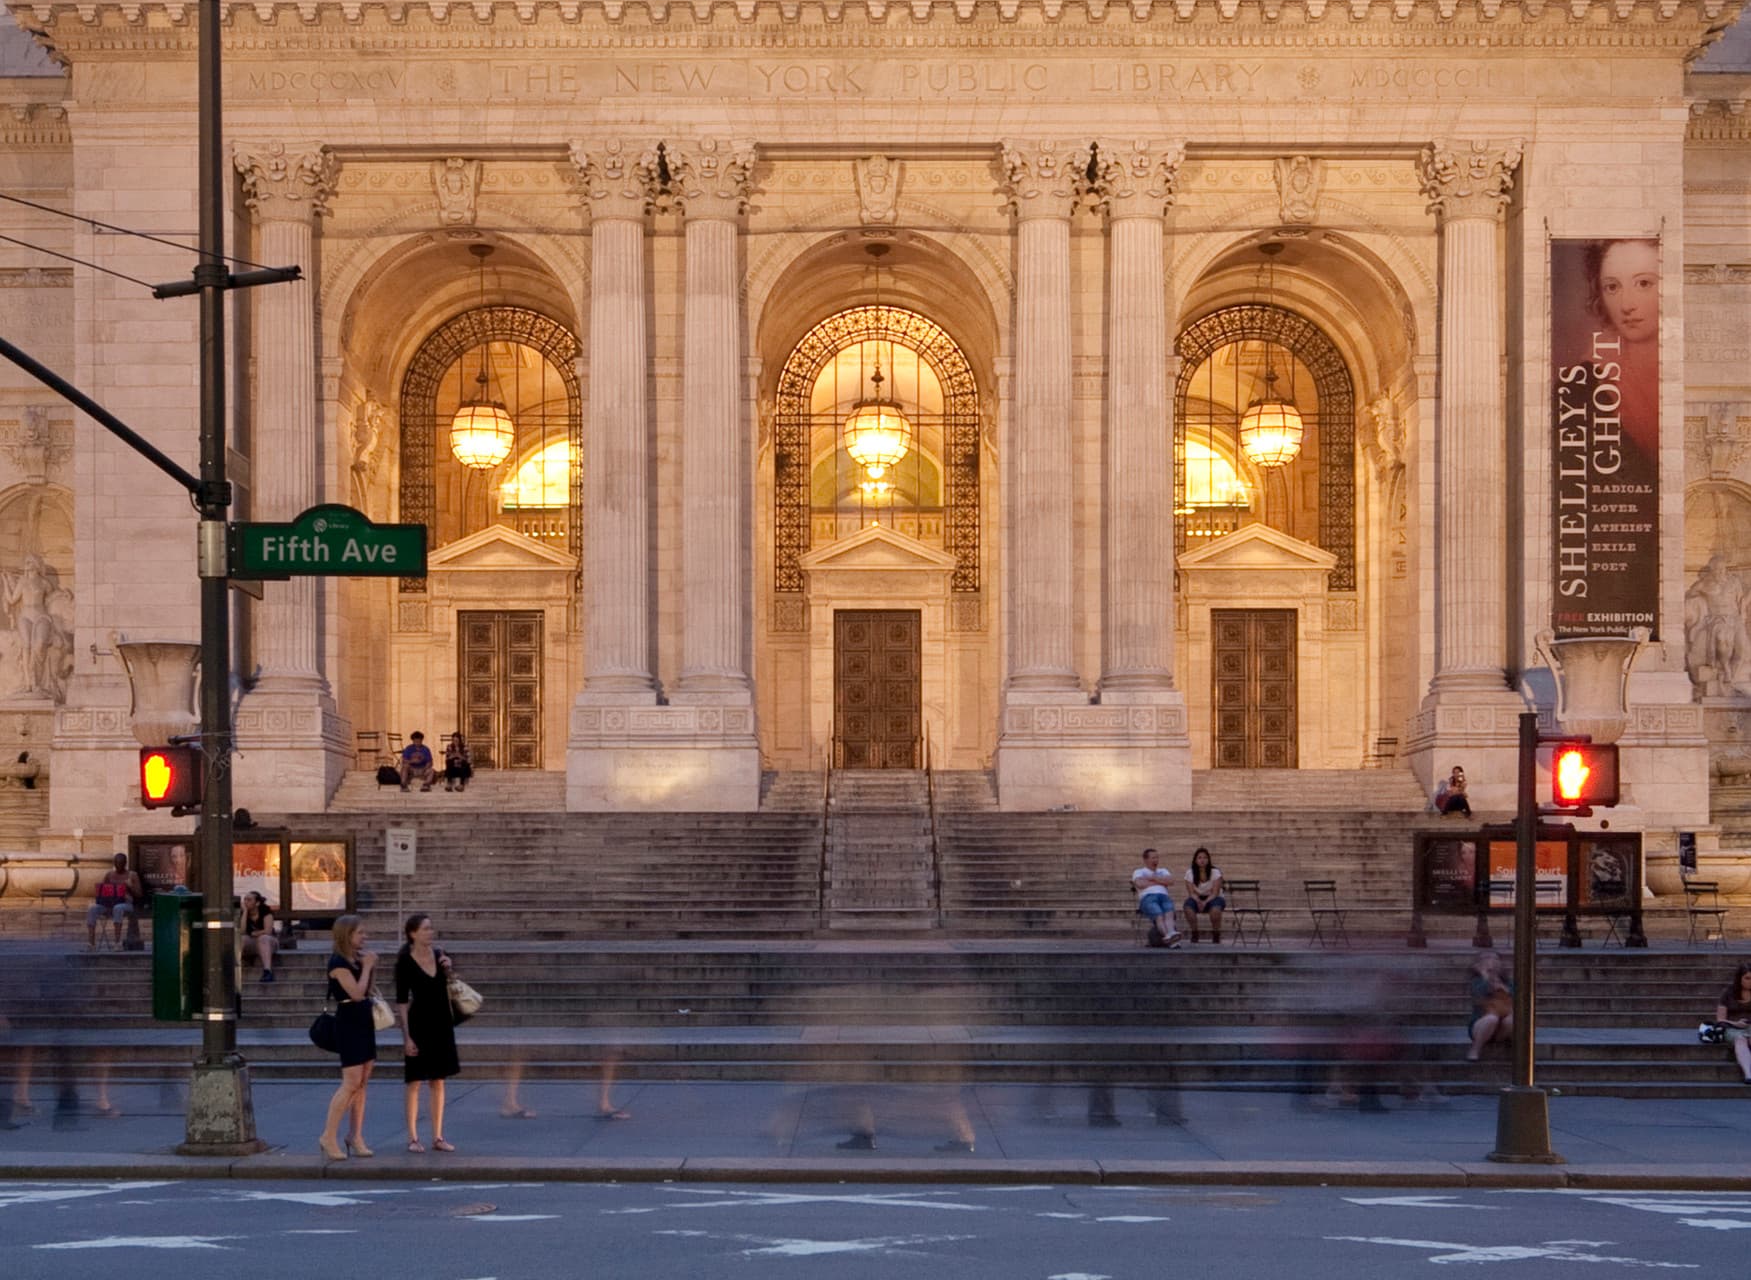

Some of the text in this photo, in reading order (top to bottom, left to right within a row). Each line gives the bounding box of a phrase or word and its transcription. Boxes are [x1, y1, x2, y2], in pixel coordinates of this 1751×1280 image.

[495, 65, 580, 93] THE
[614, 65, 716, 93] NEW
[757, 65, 864, 93] YORK
[900, 63, 1049, 93] PUBLIC
[1088, 63, 1263, 93] LIBRARY
[1593, 331, 1622, 475] GHOST
[1558, 365, 1588, 598] SHELLEY'S
[1592, 485, 1653, 493] RADICAL
[1592, 504, 1638, 513] LOVER
[1592, 524, 1653, 533] ATHEIST
[262, 536, 397, 563] Fifth Ave
[1592, 543, 1637, 552] EXILE
[1592, 563, 1628, 572] POET
[1587, 612, 1654, 623] EXHIBITION
[1558, 625, 1571, 633] The
[1573, 625, 1589, 633] New
[1590, 625, 1605, 633] York
[1606, 625, 1628, 634] Public
